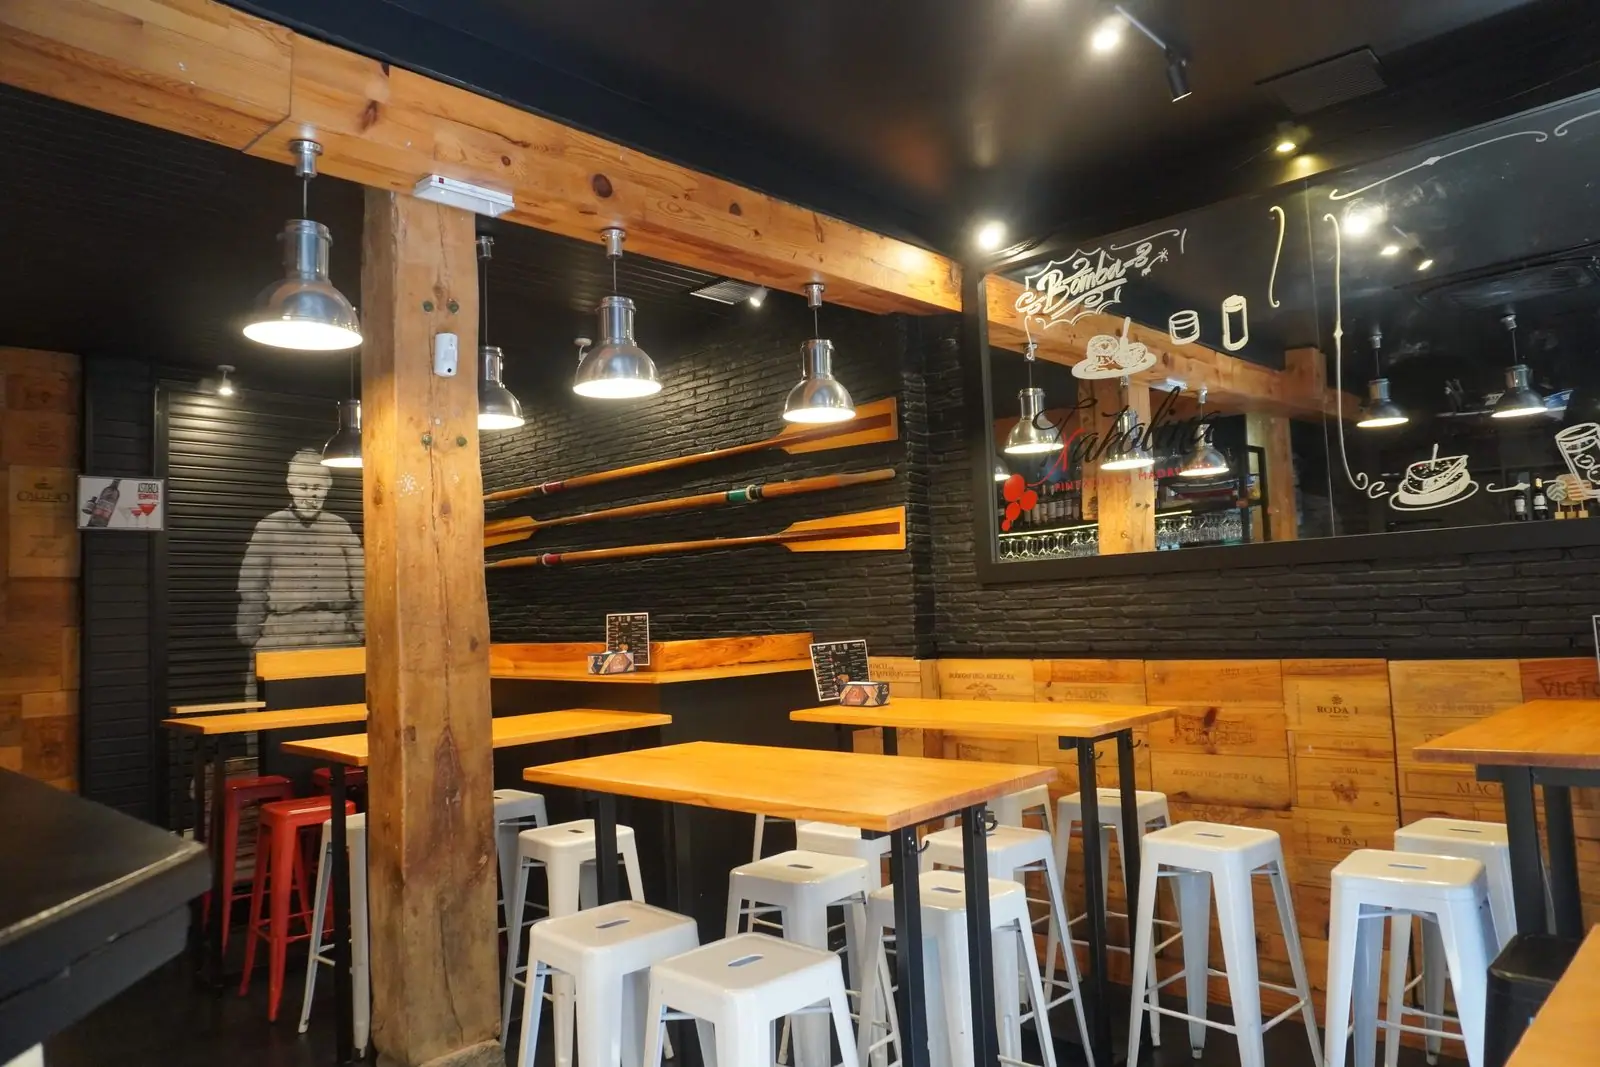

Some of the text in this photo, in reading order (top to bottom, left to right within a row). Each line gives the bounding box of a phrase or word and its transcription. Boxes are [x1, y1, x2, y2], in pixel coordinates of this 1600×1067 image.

[1317, 706, 1350, 714] RODA
[1456, 781, 1503, 796] MAC
[1326, 836, 1360, 846] RODA
